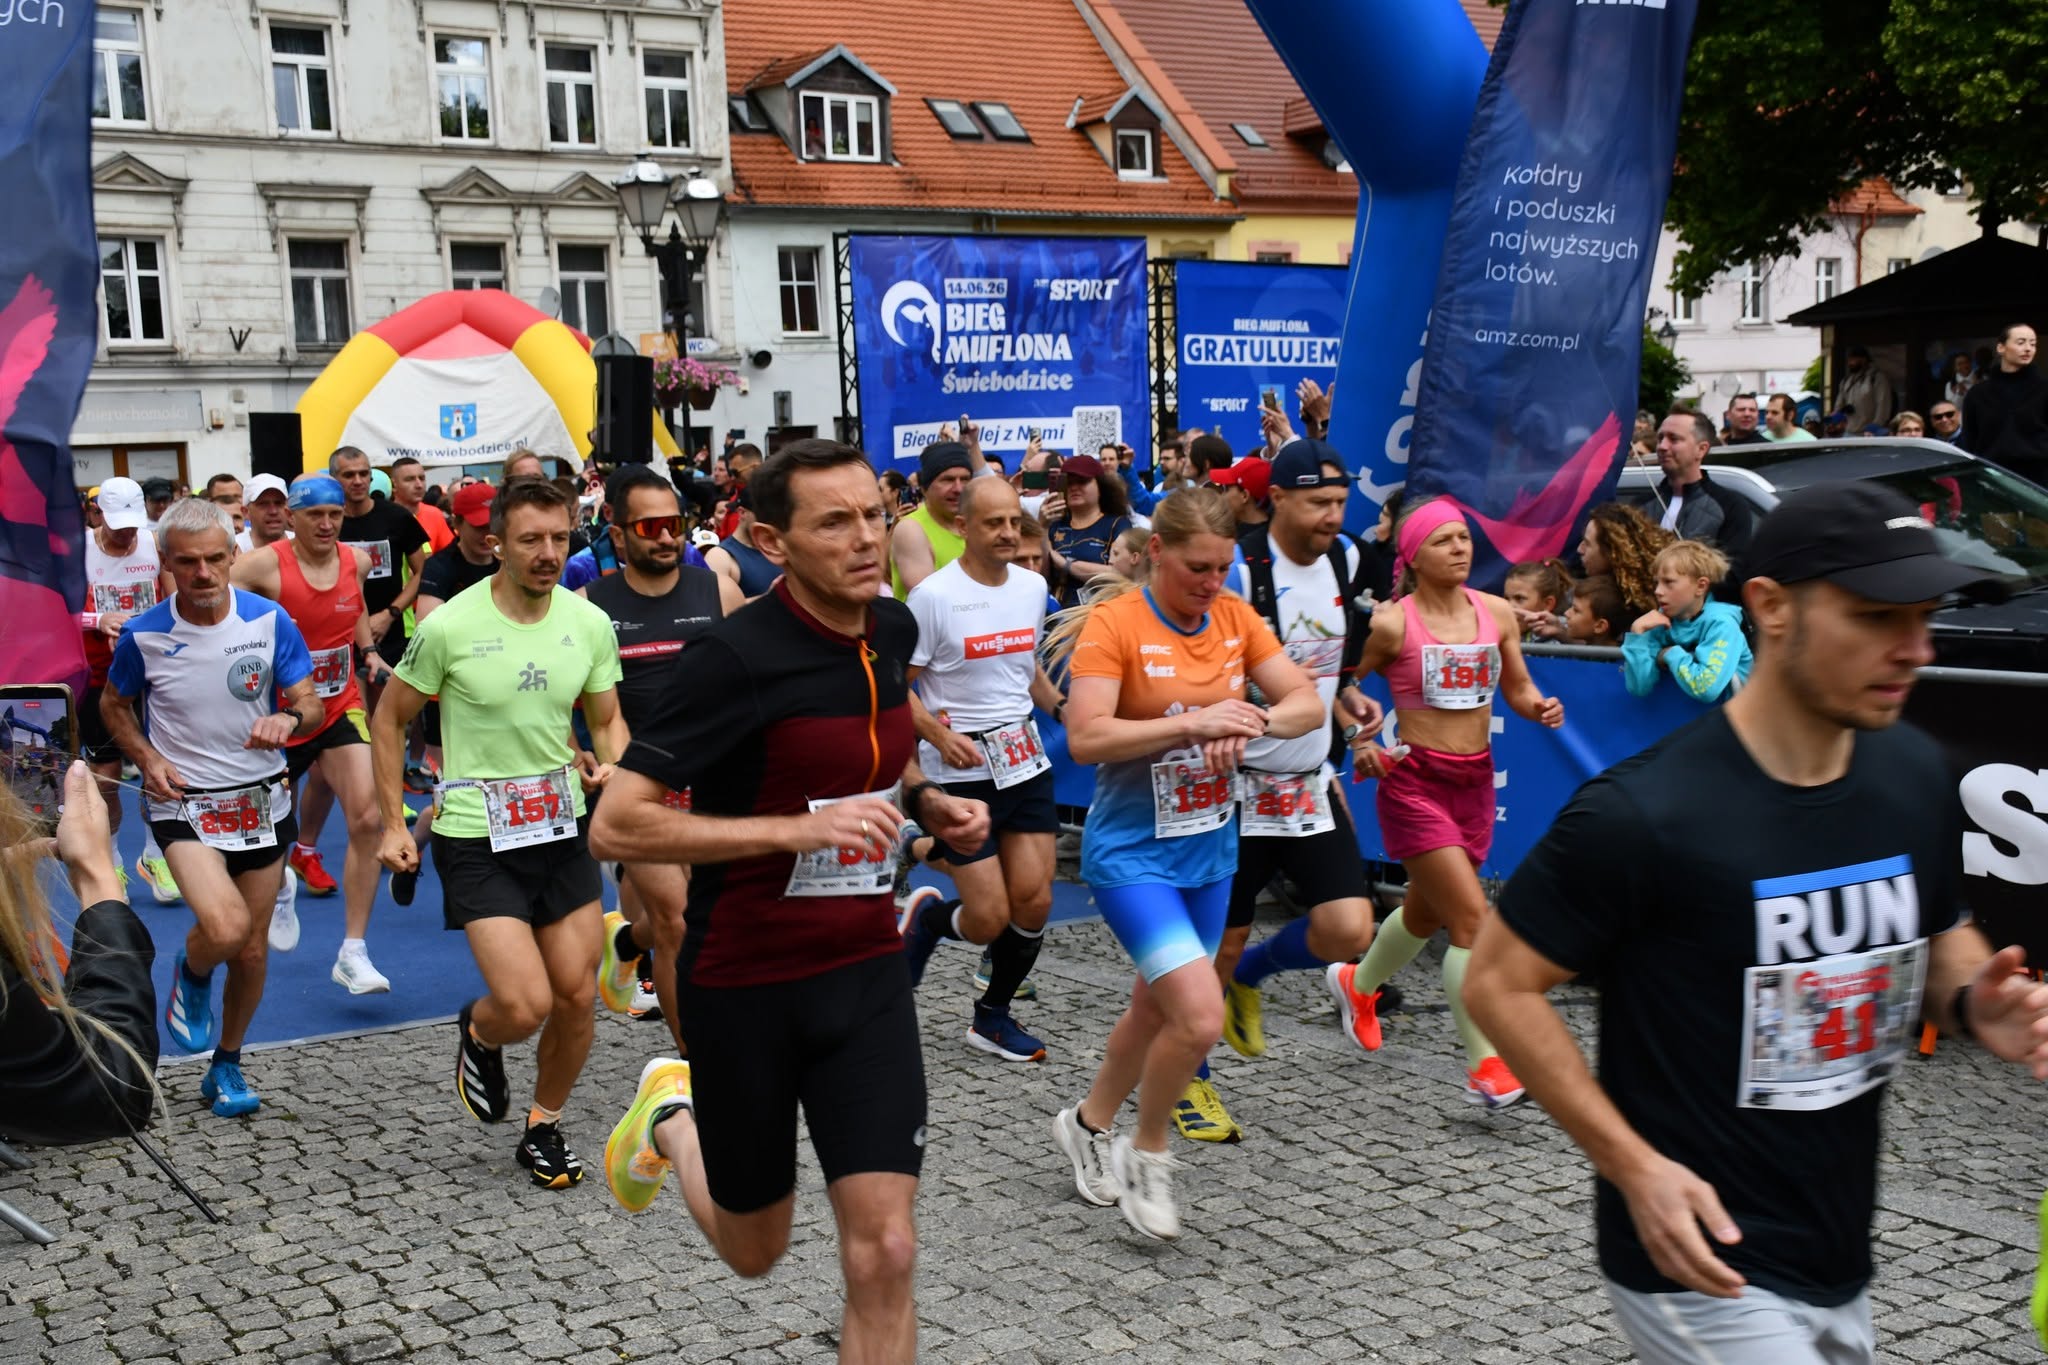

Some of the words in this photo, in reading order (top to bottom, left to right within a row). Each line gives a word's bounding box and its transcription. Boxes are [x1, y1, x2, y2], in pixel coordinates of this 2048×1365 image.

[1503, 162, 1583, 193] Kołdry
[1494, 196, 1502, 215] i
[1506, 197, 1616, 225] poduszki
[1489, 230, 1639, 263] najwyższych
[1485, 258, 1558, 286] lotów.
[948, 281, 1006, 295] 14.06.26
[1050, 279, 1120, 301] SPORT
[945, 302, 1006, 332] BIEG
[1233, 318, 1258, 332] BIEG
[1259, 319, 1310, 333] MUFLONA
[687, 340, 704, 352] WC
[944, 333, 1073, 364] MUFLONA
[1475, 328, 1580, 352] amz.com.pl
[941, 367, 1073, 395] Świebodzice
[1210, 398, 1249, 412] SPORT
[1004, 429, 1012, 441] z
[1016, 424, 1065, 441] Nmi
[125, 564, 156, 574] TOYOTA
[224, 640, 267, 656] Staropolanka
[199, 807, 260, 834] 258
[505, 793, 560, 827] 157
[1755, 873, 1920, 965] RUN
[1811, 1000, 1877, 1062] 41
